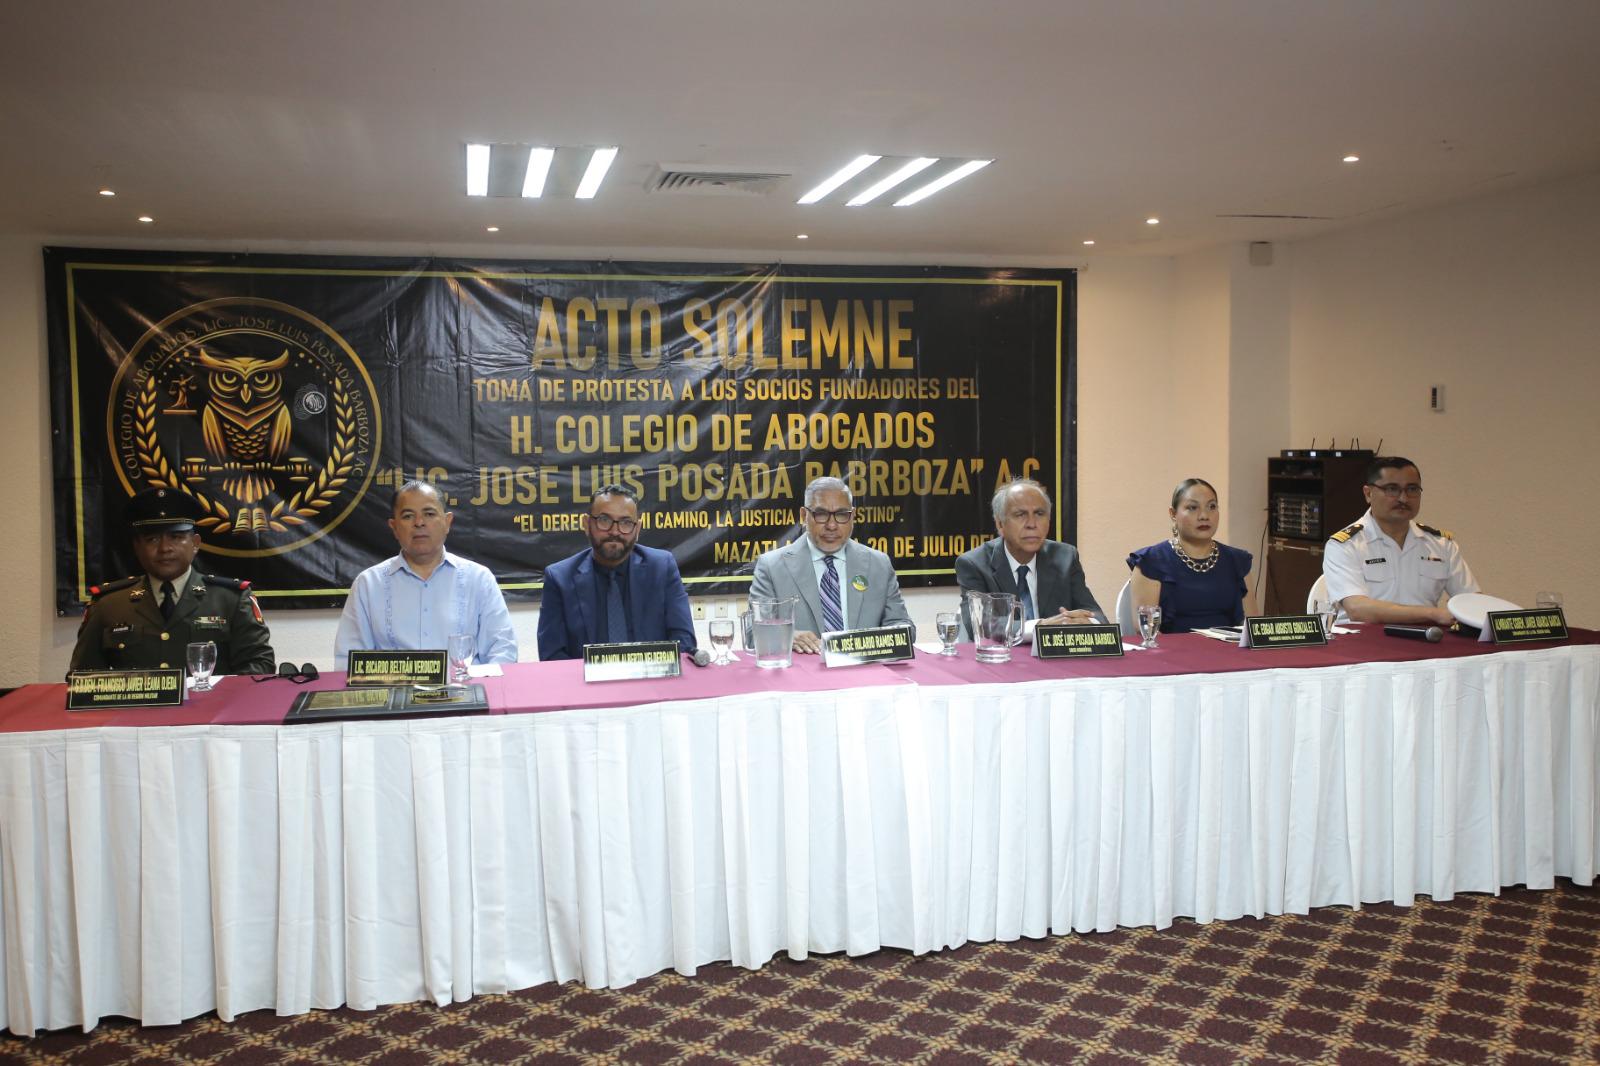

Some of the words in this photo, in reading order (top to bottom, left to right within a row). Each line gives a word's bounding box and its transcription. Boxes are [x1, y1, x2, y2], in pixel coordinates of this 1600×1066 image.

[278, 322, 310, 344] LUIS
[532, 296, 662, 371] ACTO
[682, 297, 914, 370] SOLEMNE
[310, 339, 355, 388] POSADA
[123, 390, 139, 409] DE
[473, 378, 532, 402] TOMA
[540, 378, 565, 401] DE
[572, 378, 675, 402] PROTESTA
[681, 378, 695, 401] A
[701, 378, 738, 401] LOS
[744, 378, 813, 400] SOCIOS
[819, 377, 940, 400] FUNDADORES
[946, 377, 980, 400] DEL
[350, 390, 370, 454] BARBOZA
[510, 415, 543, 455] H.
[556, 413, 698, 453] COLEGIO
[711, 413, 753, 452] DE
[763, 411, 936, 451] ABOGADOS
[121, 413, 142, 480] COLEGIO
[470, 465, 559, 506] JOSE
[571, 463, 645, 503] LUIS
[658, 461, 794, 501] POSADA
[655, 510, 712, 531] CAMINO,
[716, 510, 734, 528] LA
[737, 508, 796, 528] JUSTICIA
[893, 535, 914, 558] DE
[920, 534, 965, 558] JULIO
[829, 639, 840, 653] LIC.
[841, 634, 854, 652] JOSÉ
[875, 634, 895, 649] RAMOS
[1042, 634, 1052, 647] LIC.
[1052, 630, 1064, 647] JOSÉ
[1064, 634, 1075, 647] LUIS
[1074, 633, 1095, 646] POSADA
[1094, 632, 1117, 646] BARBOZA
[354, 660, 365, 674] LIC.
[365, 660, 389, 674] RICARDO
[389, 656, 414, 674] BELTRÁN
